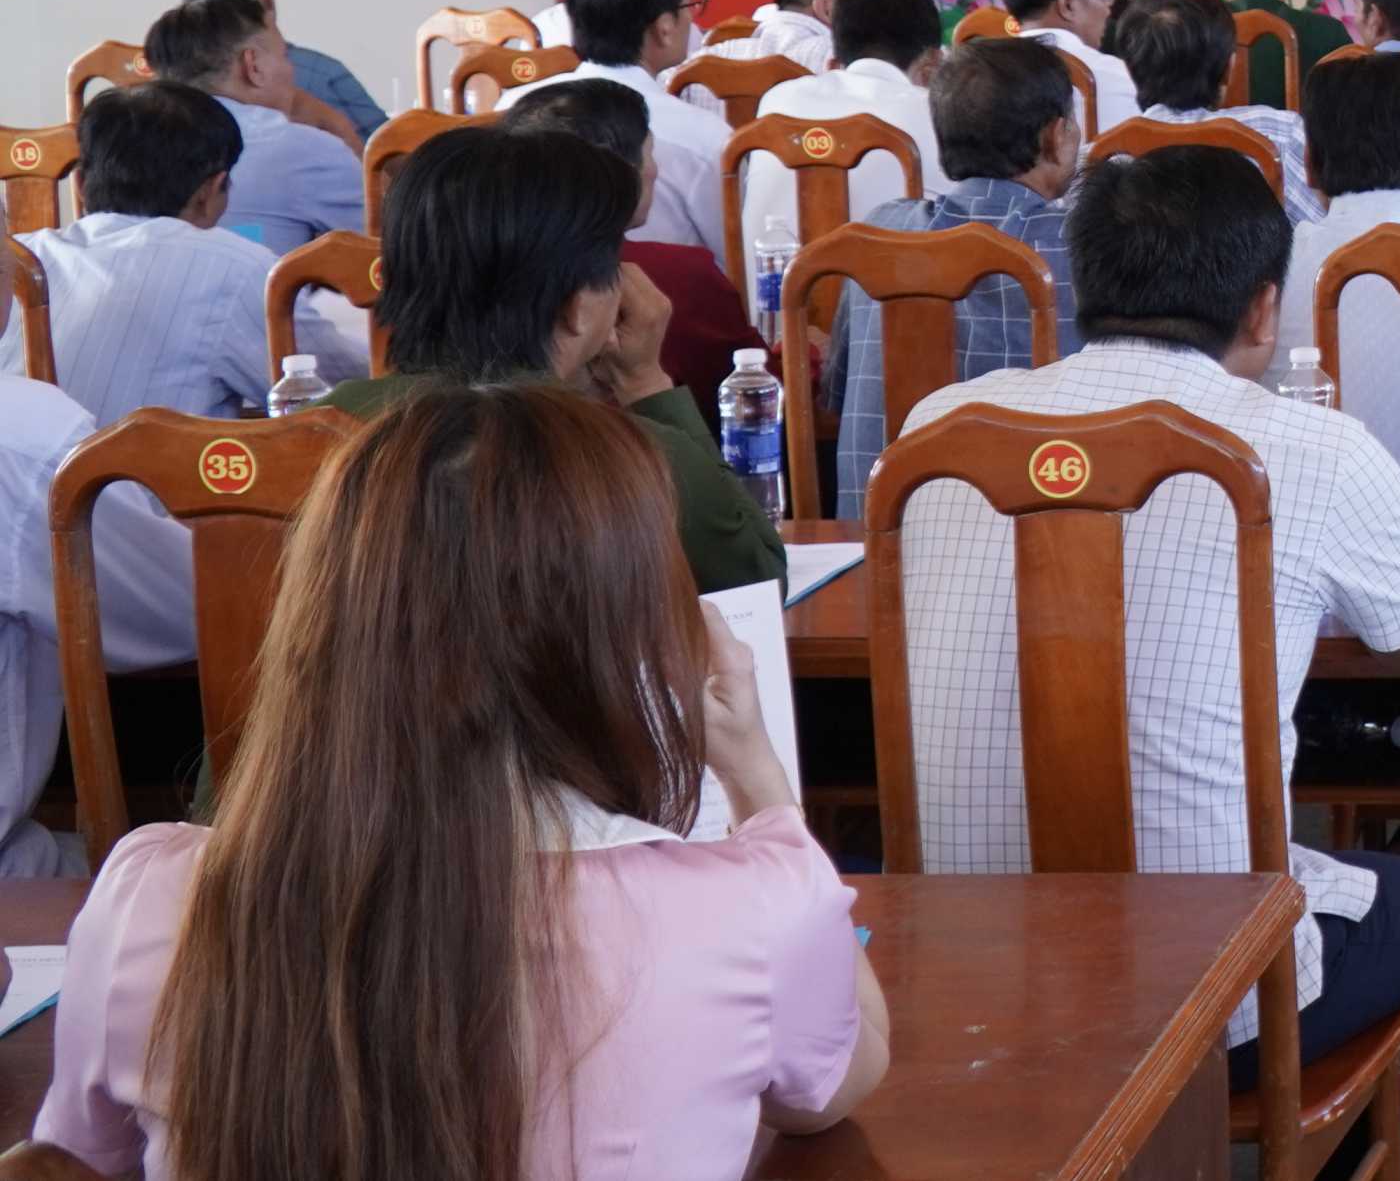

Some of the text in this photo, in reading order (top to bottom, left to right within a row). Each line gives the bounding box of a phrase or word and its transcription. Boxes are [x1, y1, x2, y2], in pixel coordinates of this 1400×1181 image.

[15, 146, 37, 162] 18
[206, 454, 249, 480] 35
[1038, 456, 1083, 482] 46
